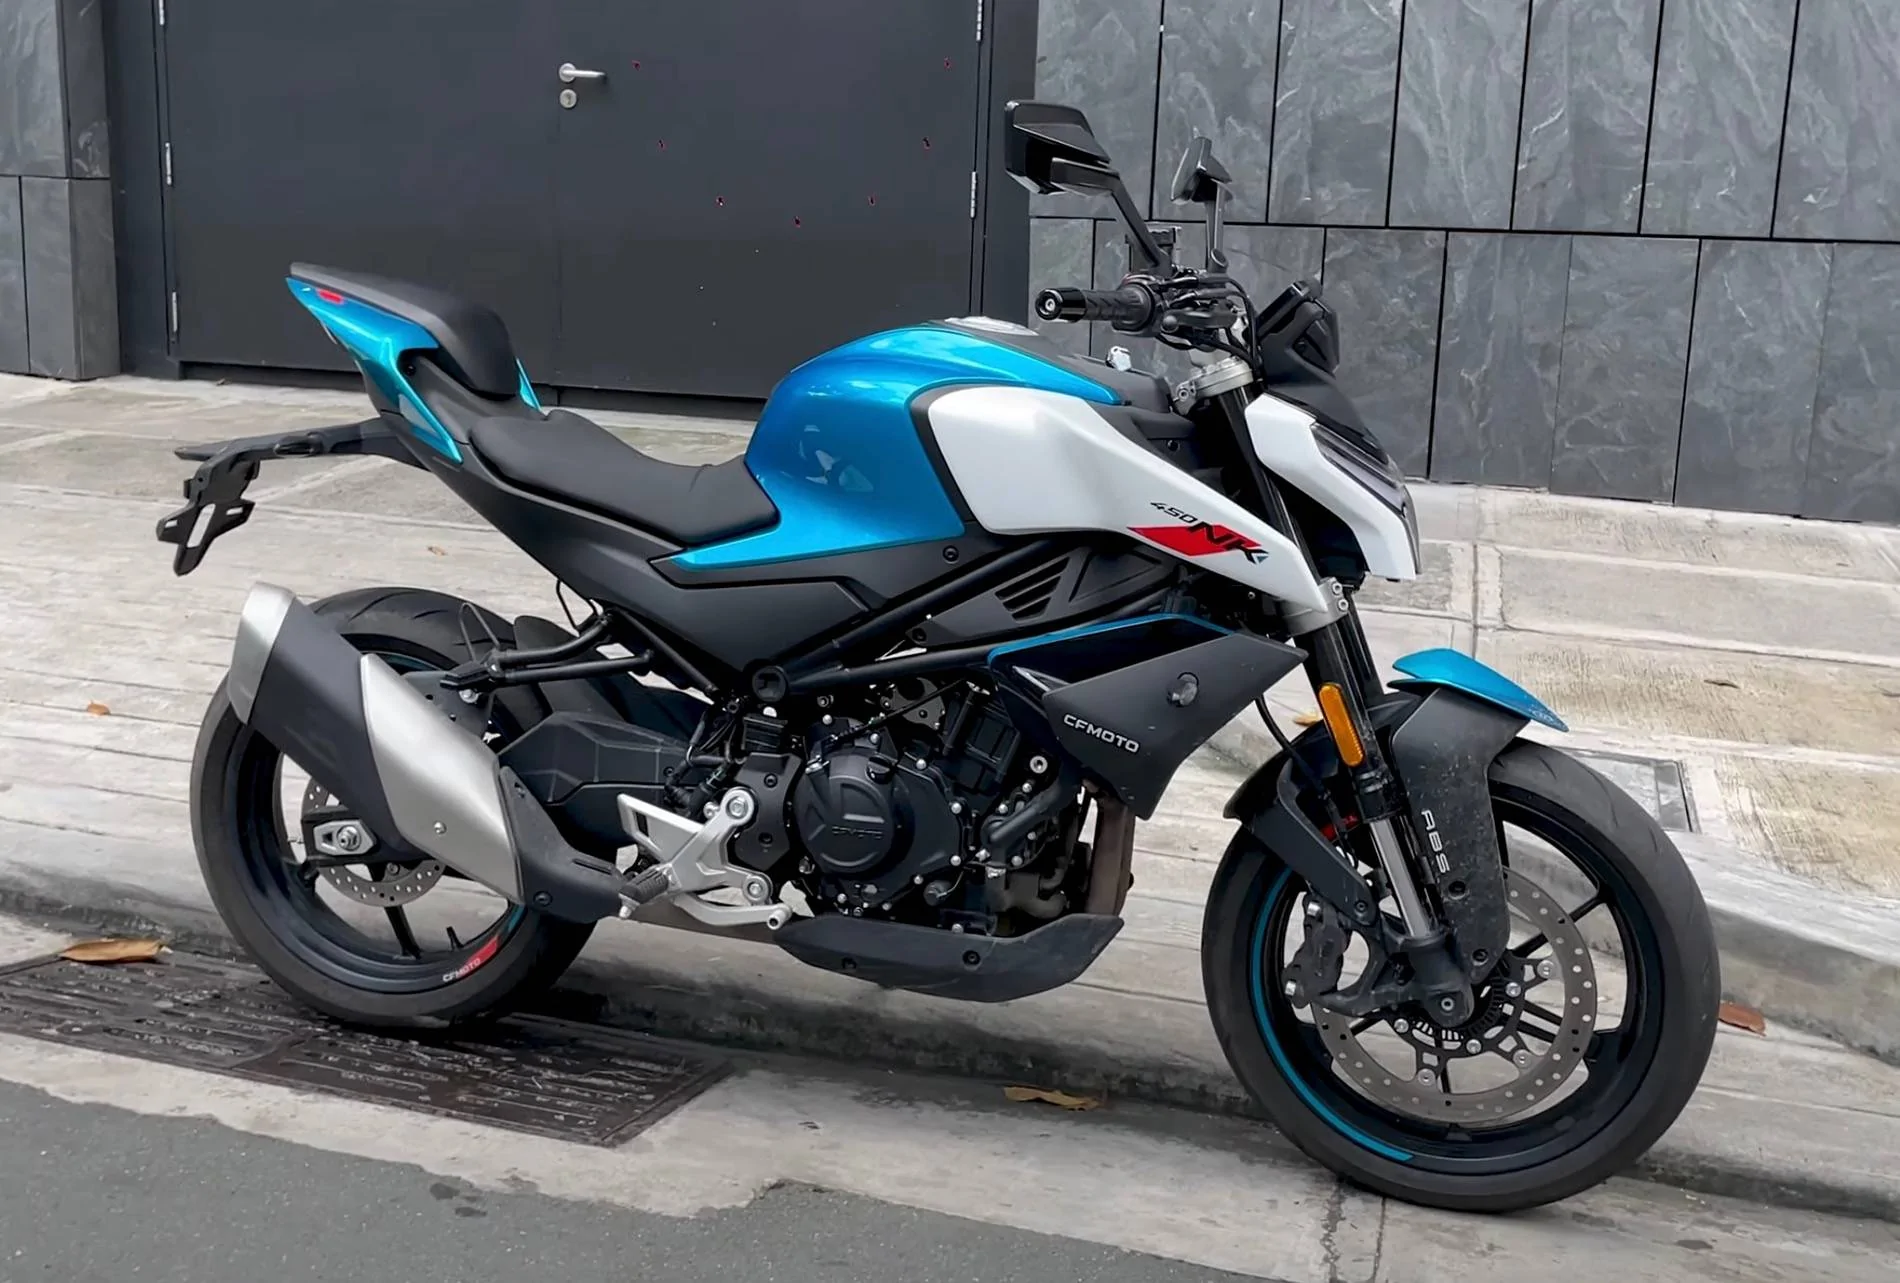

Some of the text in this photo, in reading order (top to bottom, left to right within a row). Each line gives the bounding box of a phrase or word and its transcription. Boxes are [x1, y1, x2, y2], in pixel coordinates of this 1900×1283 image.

[1150, 502, 1269, 565] 450 NK
[1063, 713, 1140, 753] CFMOTO
[1421, 809, 1450, 874] ABS
[442, 957, 481, 983] CFMOTO
